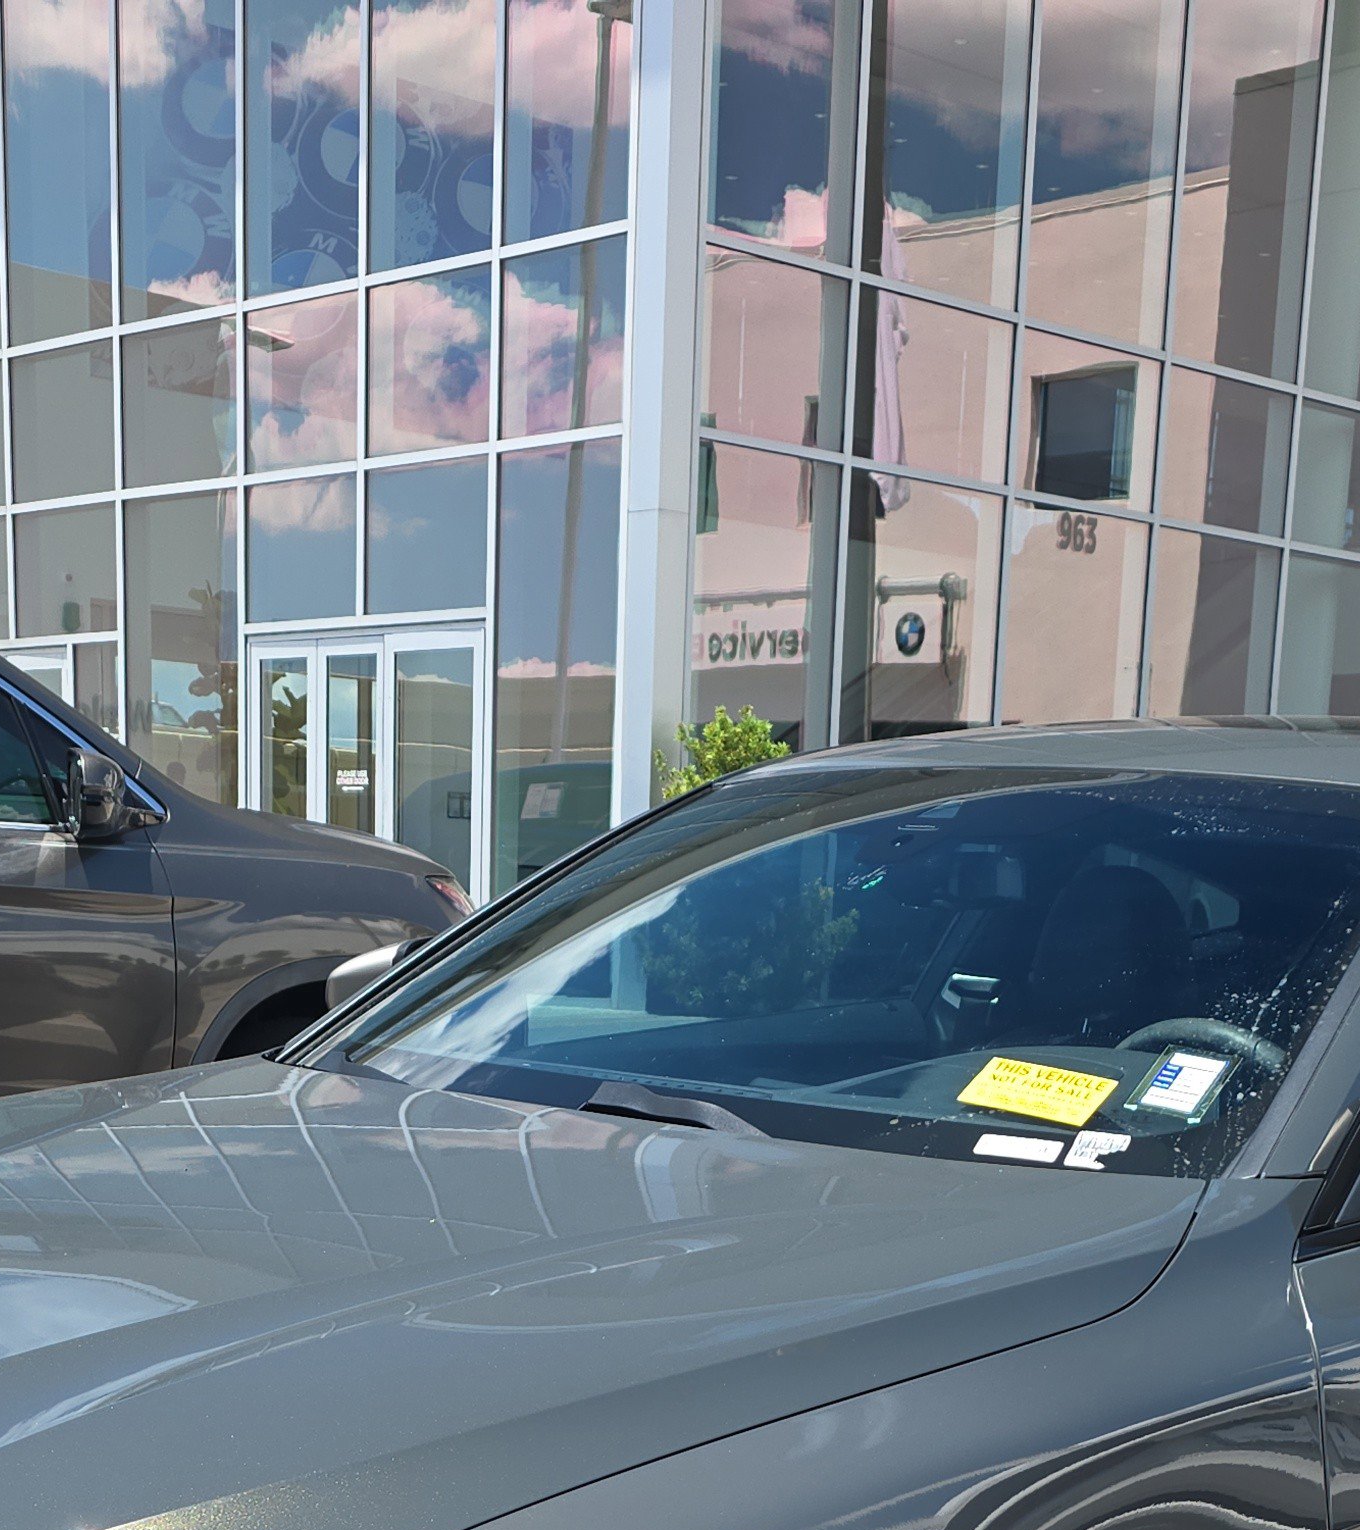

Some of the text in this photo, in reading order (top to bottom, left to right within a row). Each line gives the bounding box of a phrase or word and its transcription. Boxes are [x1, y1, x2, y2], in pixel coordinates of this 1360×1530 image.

[991, 1073, 1092, 1100] NOT FOR SALE
[996, 1061, 1109, 1092] THIS VEHICLE
